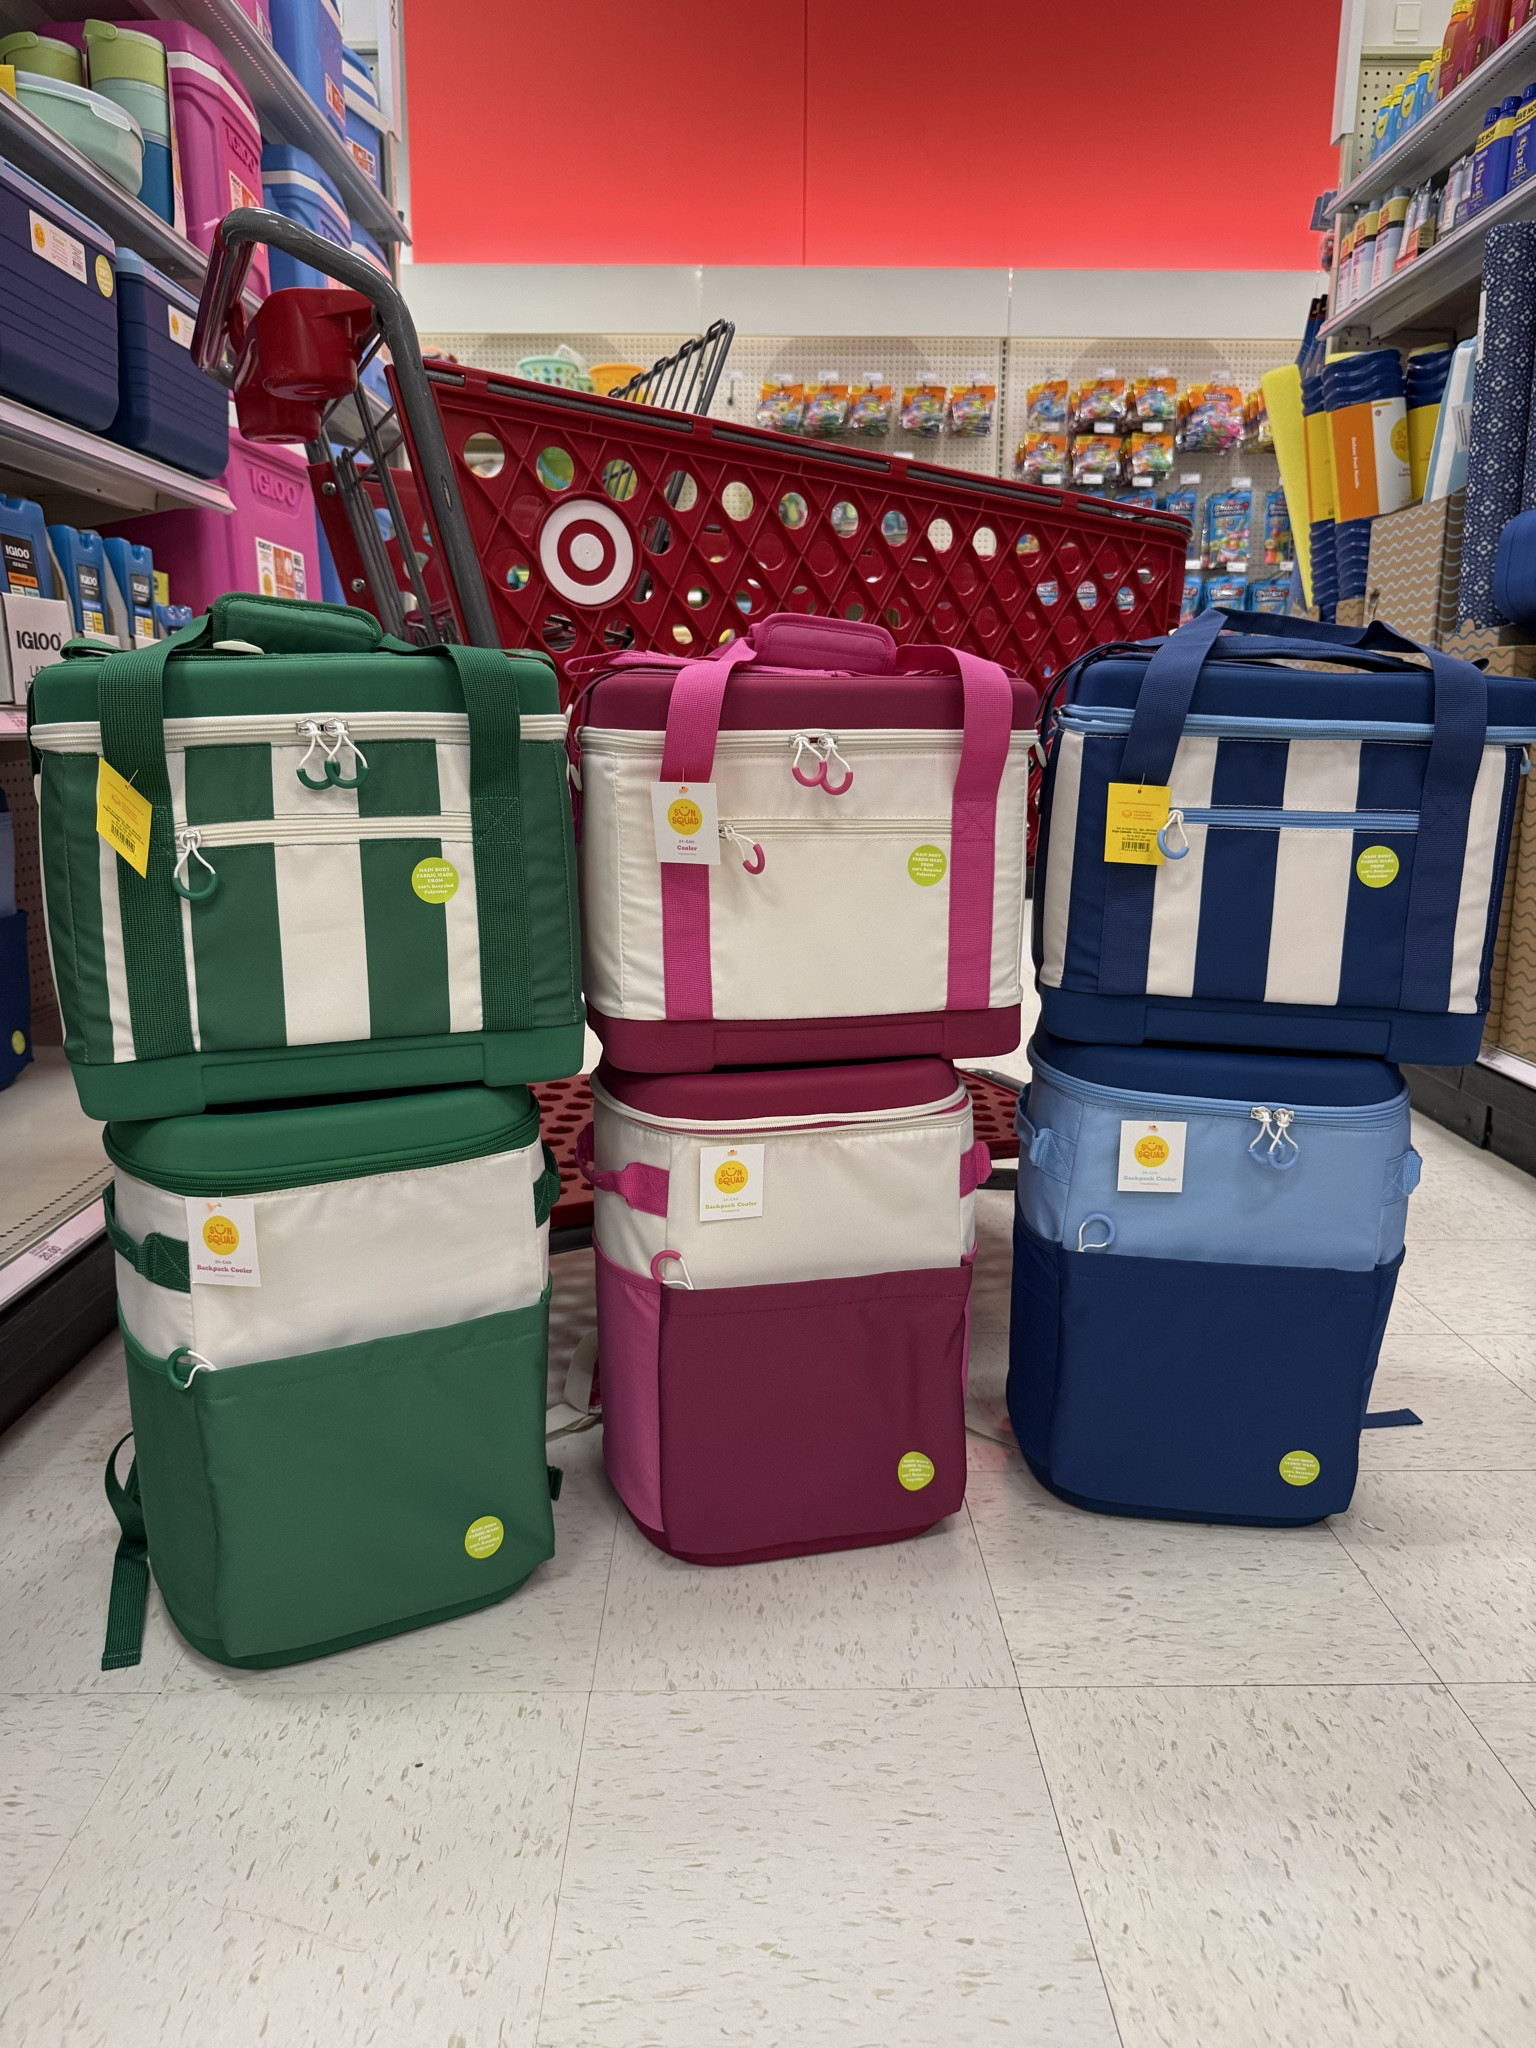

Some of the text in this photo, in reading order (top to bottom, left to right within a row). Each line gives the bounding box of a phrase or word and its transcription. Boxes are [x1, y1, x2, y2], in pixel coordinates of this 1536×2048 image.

[250, 467, 297, 507] IGLOO
[5, 544, 30, 559] IGLOO
[80, 574, 97, 587] IGLOO
[16, 630, 61, 651] IGLOO
[674, 806, 696, 817] SUN
[672, 816, 699, 826] SQUAD
[1141, 1142, 1163, 1151] SUN
[1138, 1151, 1165, 1159] SQUAD
[721, 1167, 742, 1177] SUN
[719, 1176, 745, 1186] SQUAD
[209, 1224, 232, 1235] SUN
[207, 1234, 235, 1245] SQUAD
[196, 1264, 229, 1273] Backpack
